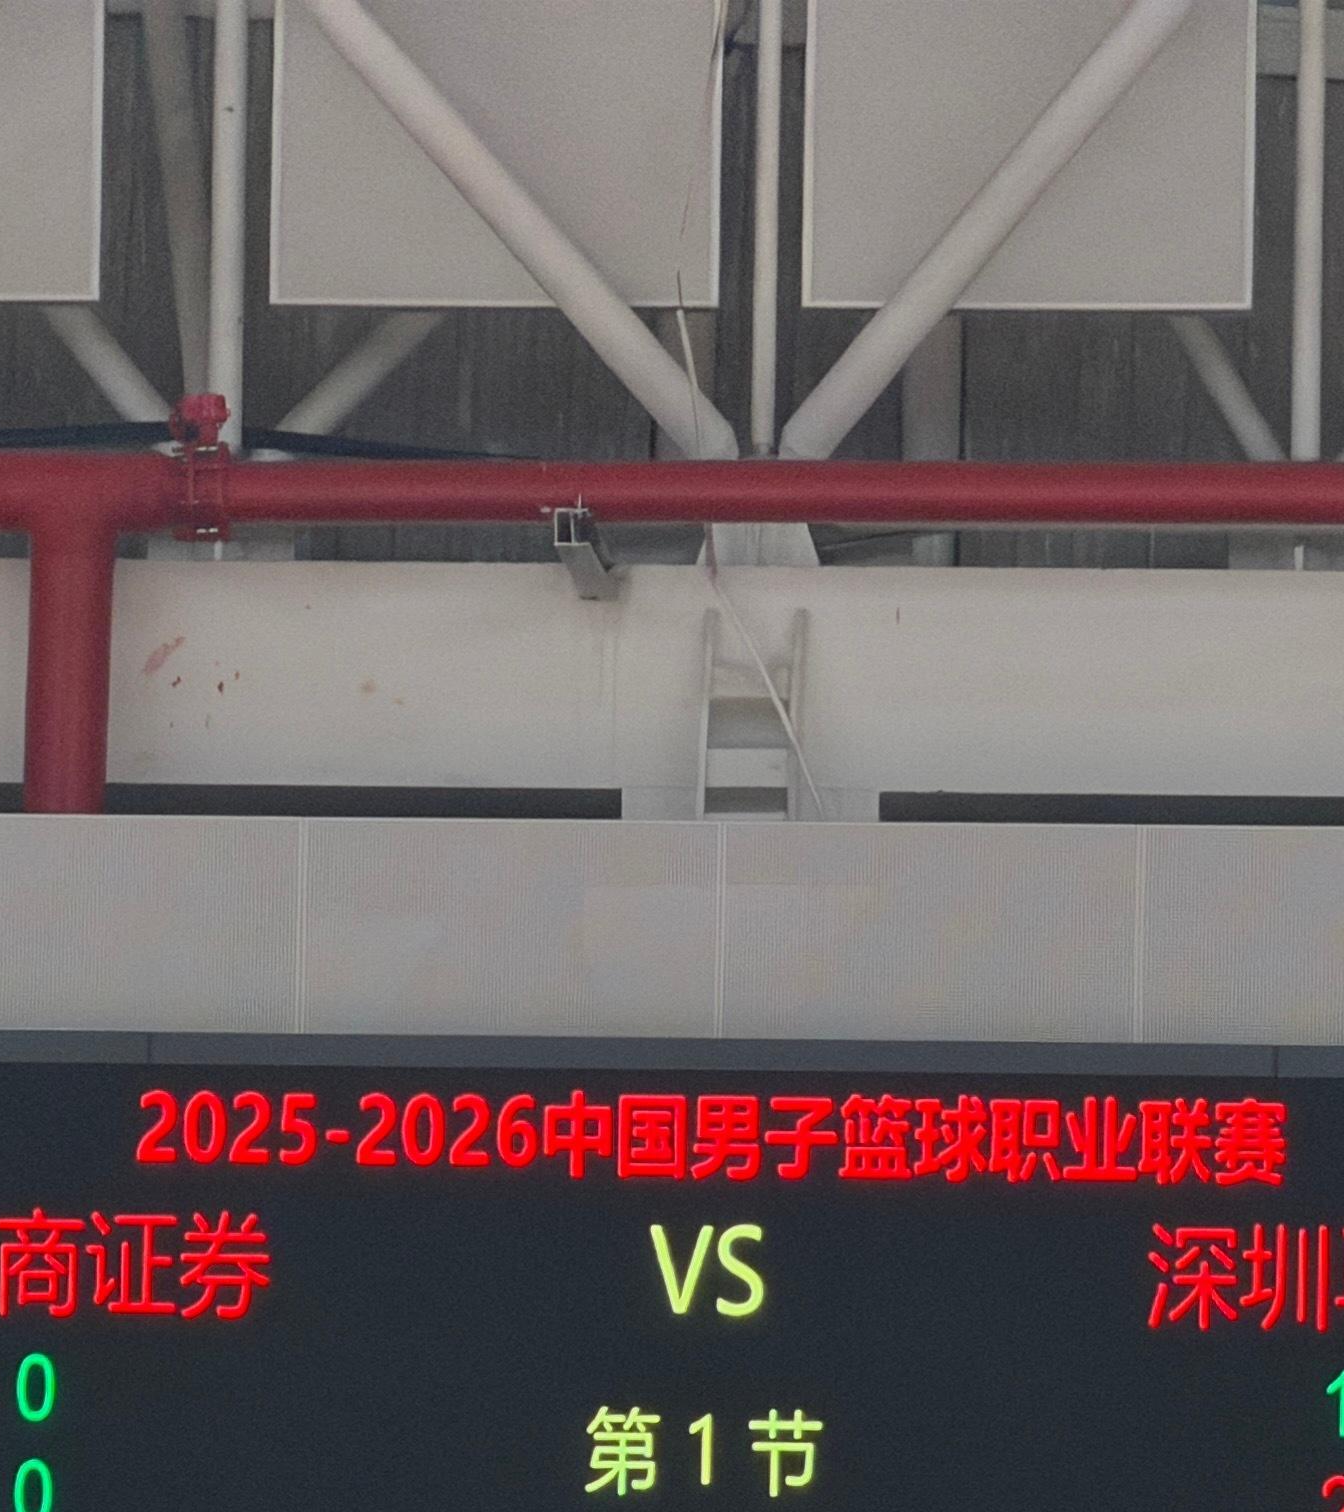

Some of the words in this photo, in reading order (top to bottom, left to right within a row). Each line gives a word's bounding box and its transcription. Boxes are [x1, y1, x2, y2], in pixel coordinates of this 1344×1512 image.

[134, 1087, 1290, 1190] 2025-2026中国男子篮球职业联赛
[648, 1222, 766, 1319] VS
[15, 1351, 57, 1424] 0
